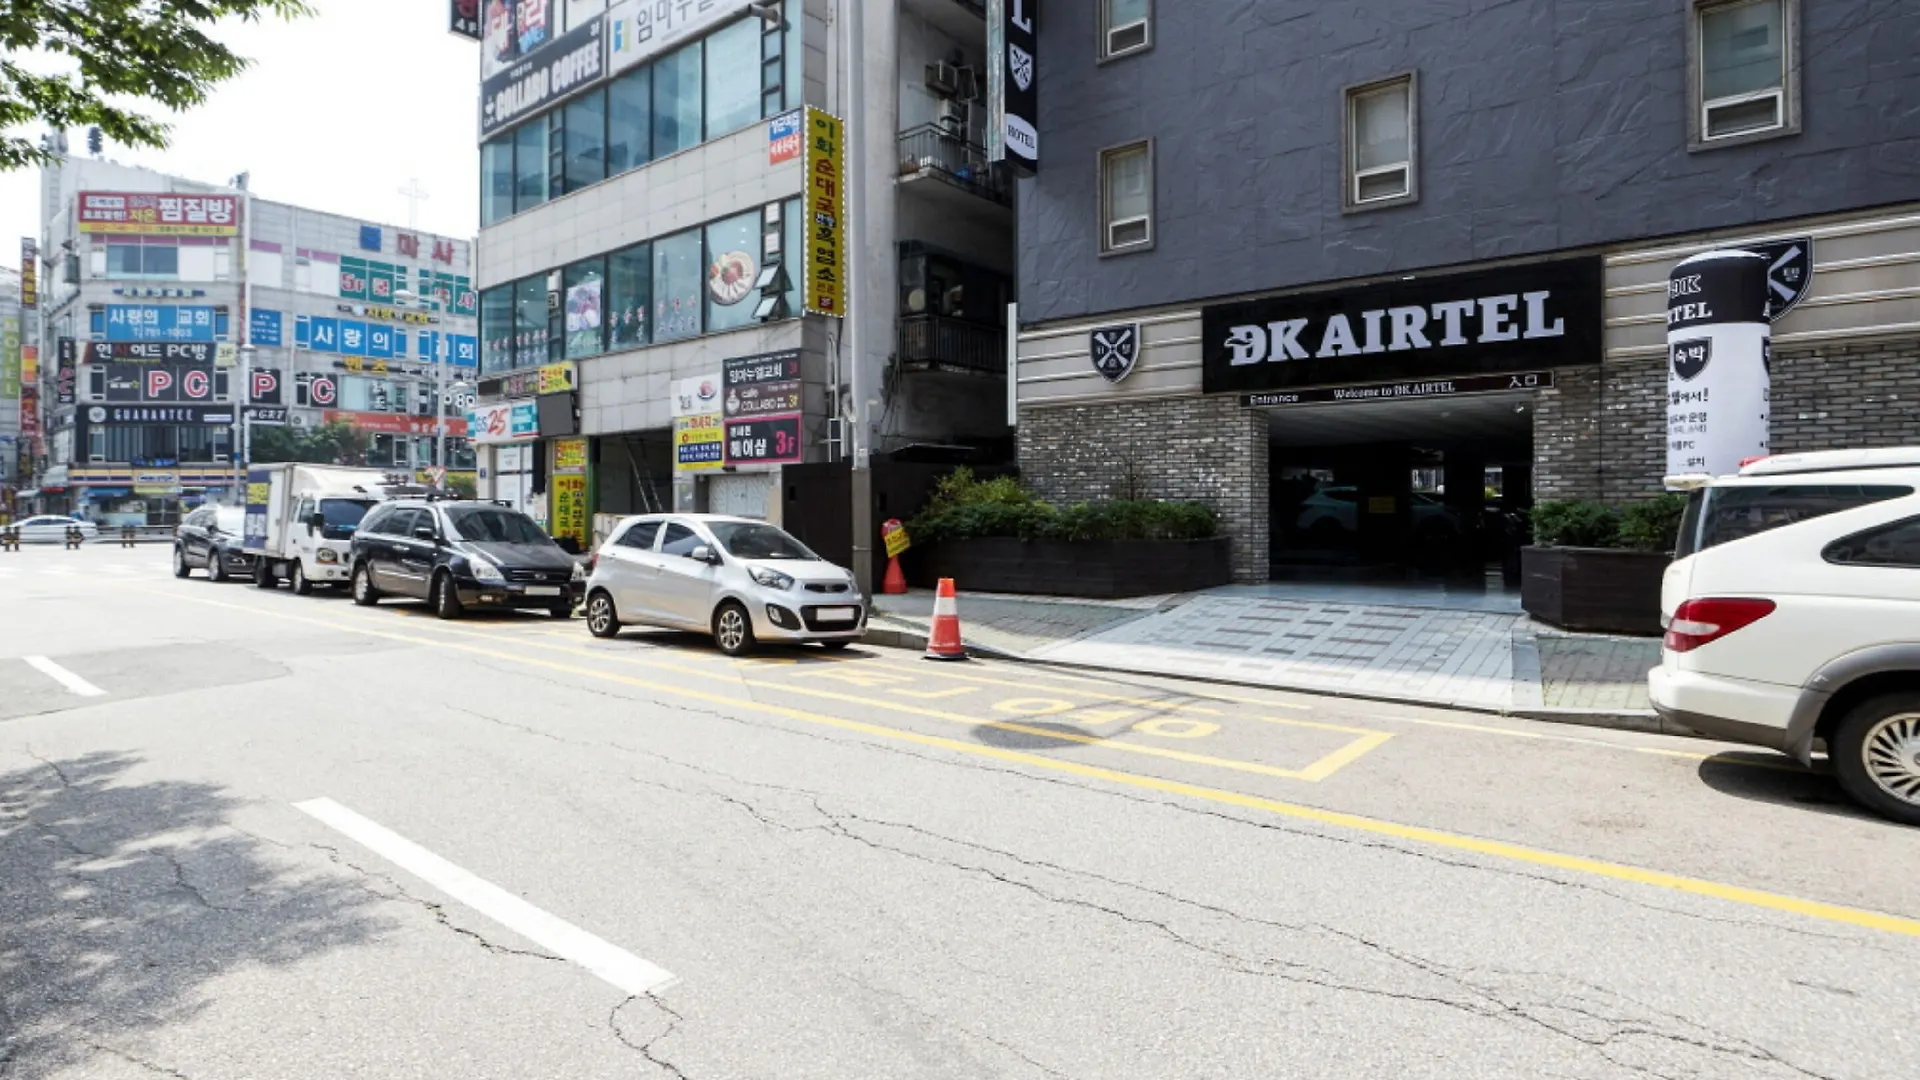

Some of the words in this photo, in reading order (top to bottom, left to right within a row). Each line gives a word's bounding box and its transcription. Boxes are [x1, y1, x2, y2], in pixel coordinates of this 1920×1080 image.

[552, 39, 600, 94] COFFEE
[815, 118, 835, 158] 이화
[1008, 125, 1035, 149] HOTEL
[159, 197, 233, 224] 찜질방
[110, 308, 159, 325] 사랑의
[178, 309, 210, 325] 교회
[1668, 302, 1713, 324] TEL
[314, 325, 389, 351] 사랑의
[1224, 317, 1309, 366] DK
[1315, 290, 1564, 357] AIRTEL
[4, 318, 19, 395] MOTEL
[95, 343, 162, 359] 인사이드
[167, 343, 207, 361] PC방
[1674, 346, 1705, 364] 숙박
[1250, 393, 1299, 405] Entrance
[1334, 386, 1379, 400] Welcome
[1382, 387, 1392, 398] to
[1412, 380, 1455, 396] AIRTEL
[113, 408, 193, 421] GUARANTEE
[741, 398, 776, 411] COLLABO
[775, 430, 795, 455] 3F
